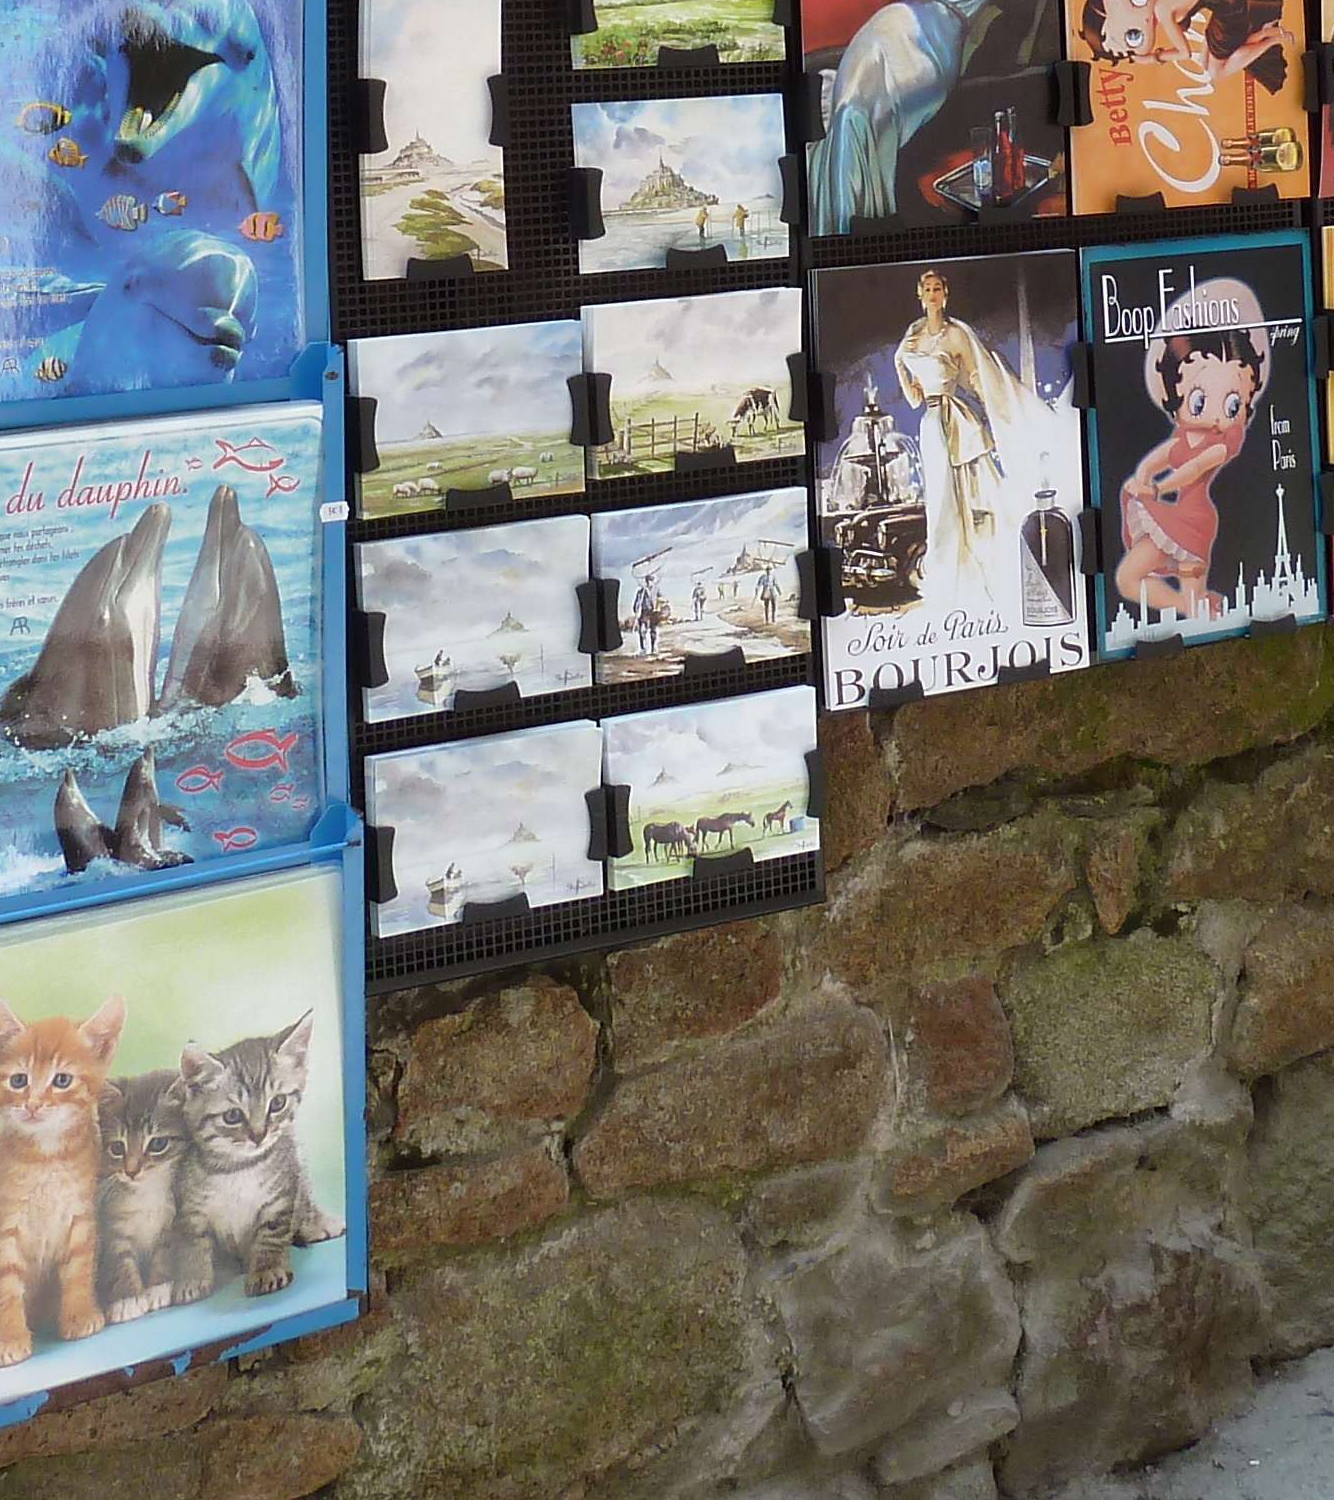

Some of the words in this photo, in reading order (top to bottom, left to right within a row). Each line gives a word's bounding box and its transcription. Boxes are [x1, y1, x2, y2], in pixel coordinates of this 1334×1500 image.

[1094, 67, 1135, 147] Betty
[1101, 274, 1155, 350] Boop
[1157, 265, 1240, 334] Fashions
[1269, 404, 1291, 436] from
[1271, 438, 1297, 471] Paris
[4, 459, 46, 515] du
[847, 621, 908, 657] Soir
[916, 621, 939, 647] de
[943, 609, 1009, 642] Paris
[833, 631, 1085, 707] BOURJOIS
